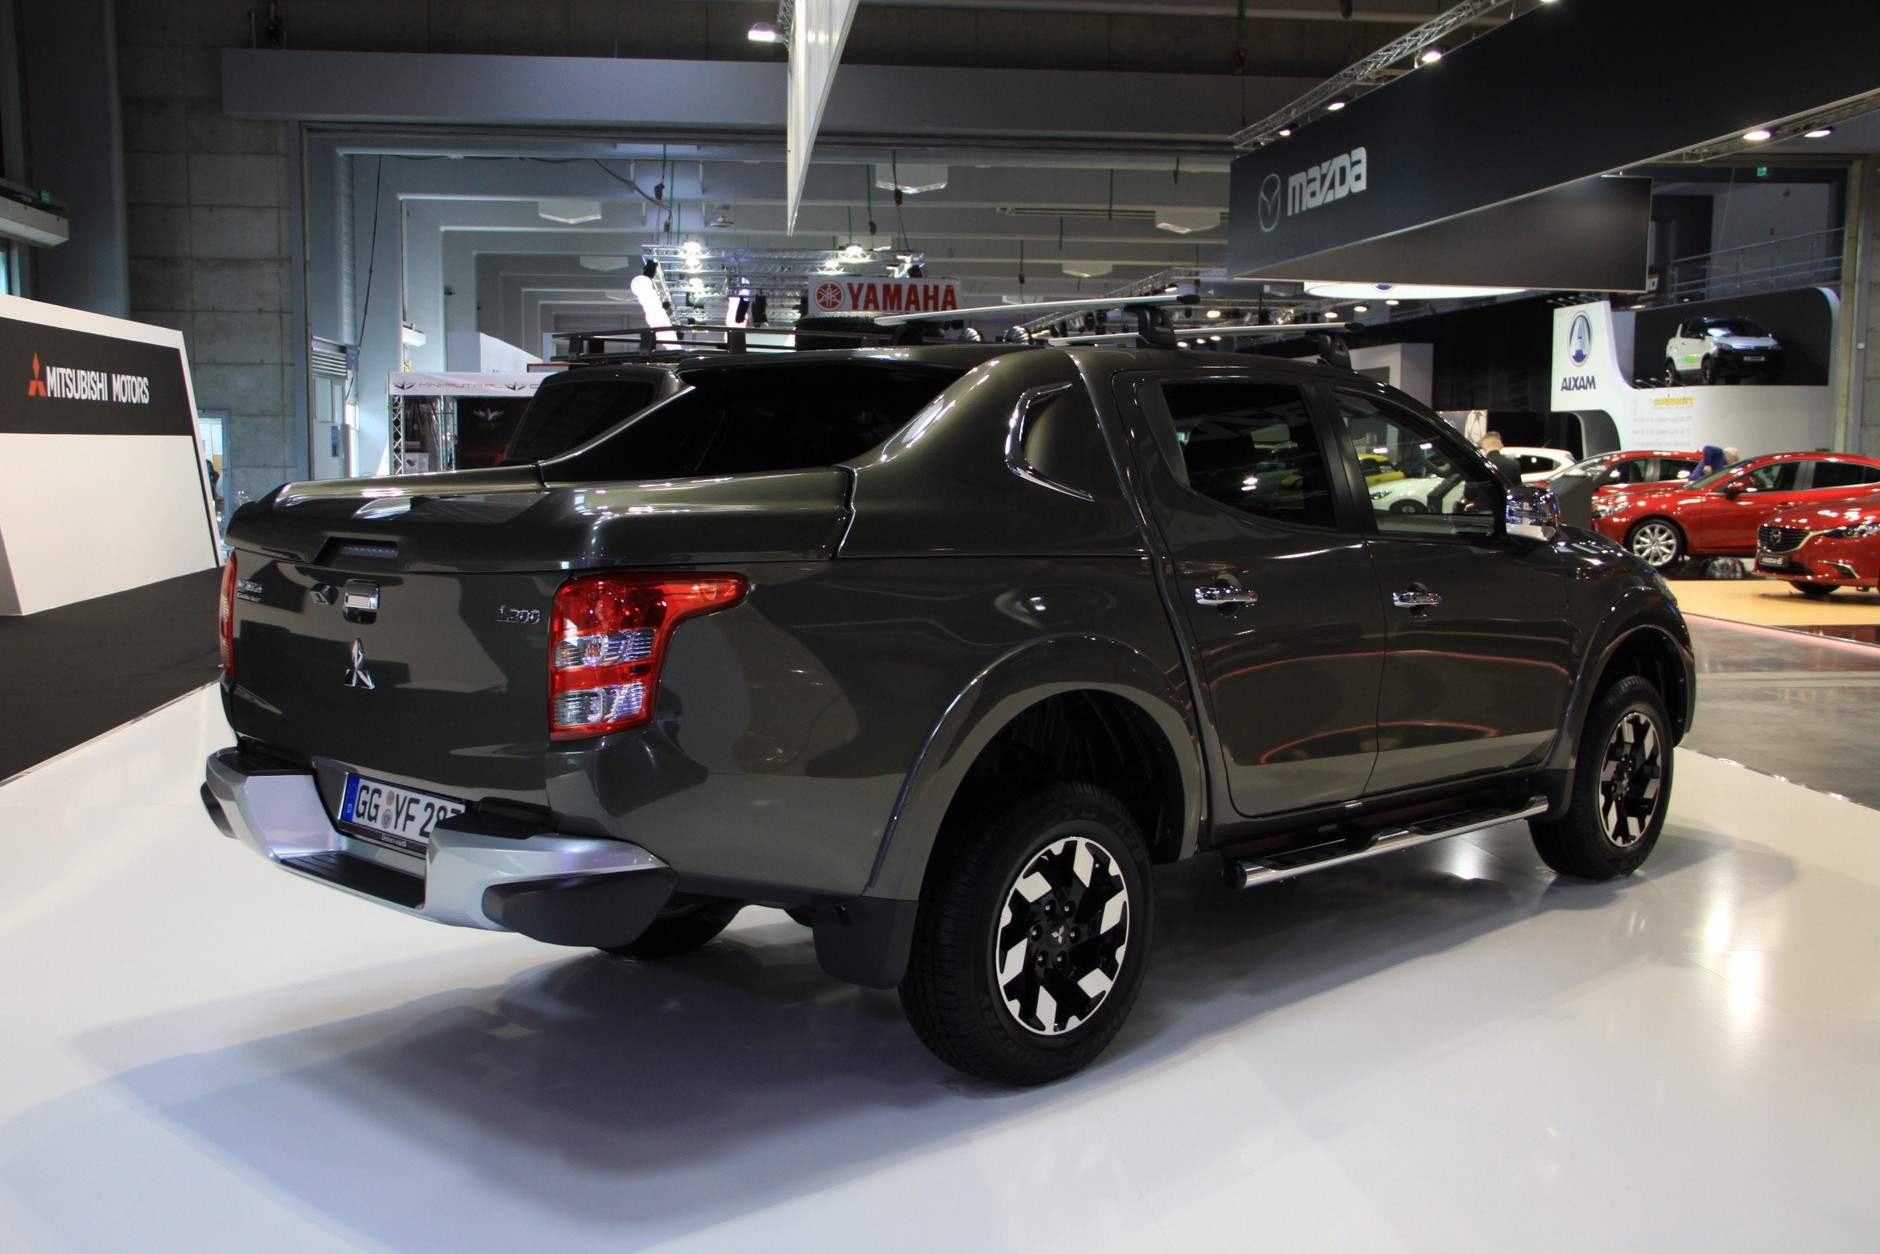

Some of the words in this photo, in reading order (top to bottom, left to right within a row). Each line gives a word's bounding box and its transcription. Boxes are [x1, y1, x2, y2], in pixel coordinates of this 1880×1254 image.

[1287, 146, 1367, 216] mazda
[847, 282, 958, 312] YAMAHA
[46, 366, 109, 401] MITSUBISHI
[112, 373, 149, 405] MOTORS
[1560, 375, 1597, 392] AIXAM
[497, 604, 540, 624] L200
[355, 784, 382, 823] GG
[394, 794, 420, 832] YF
